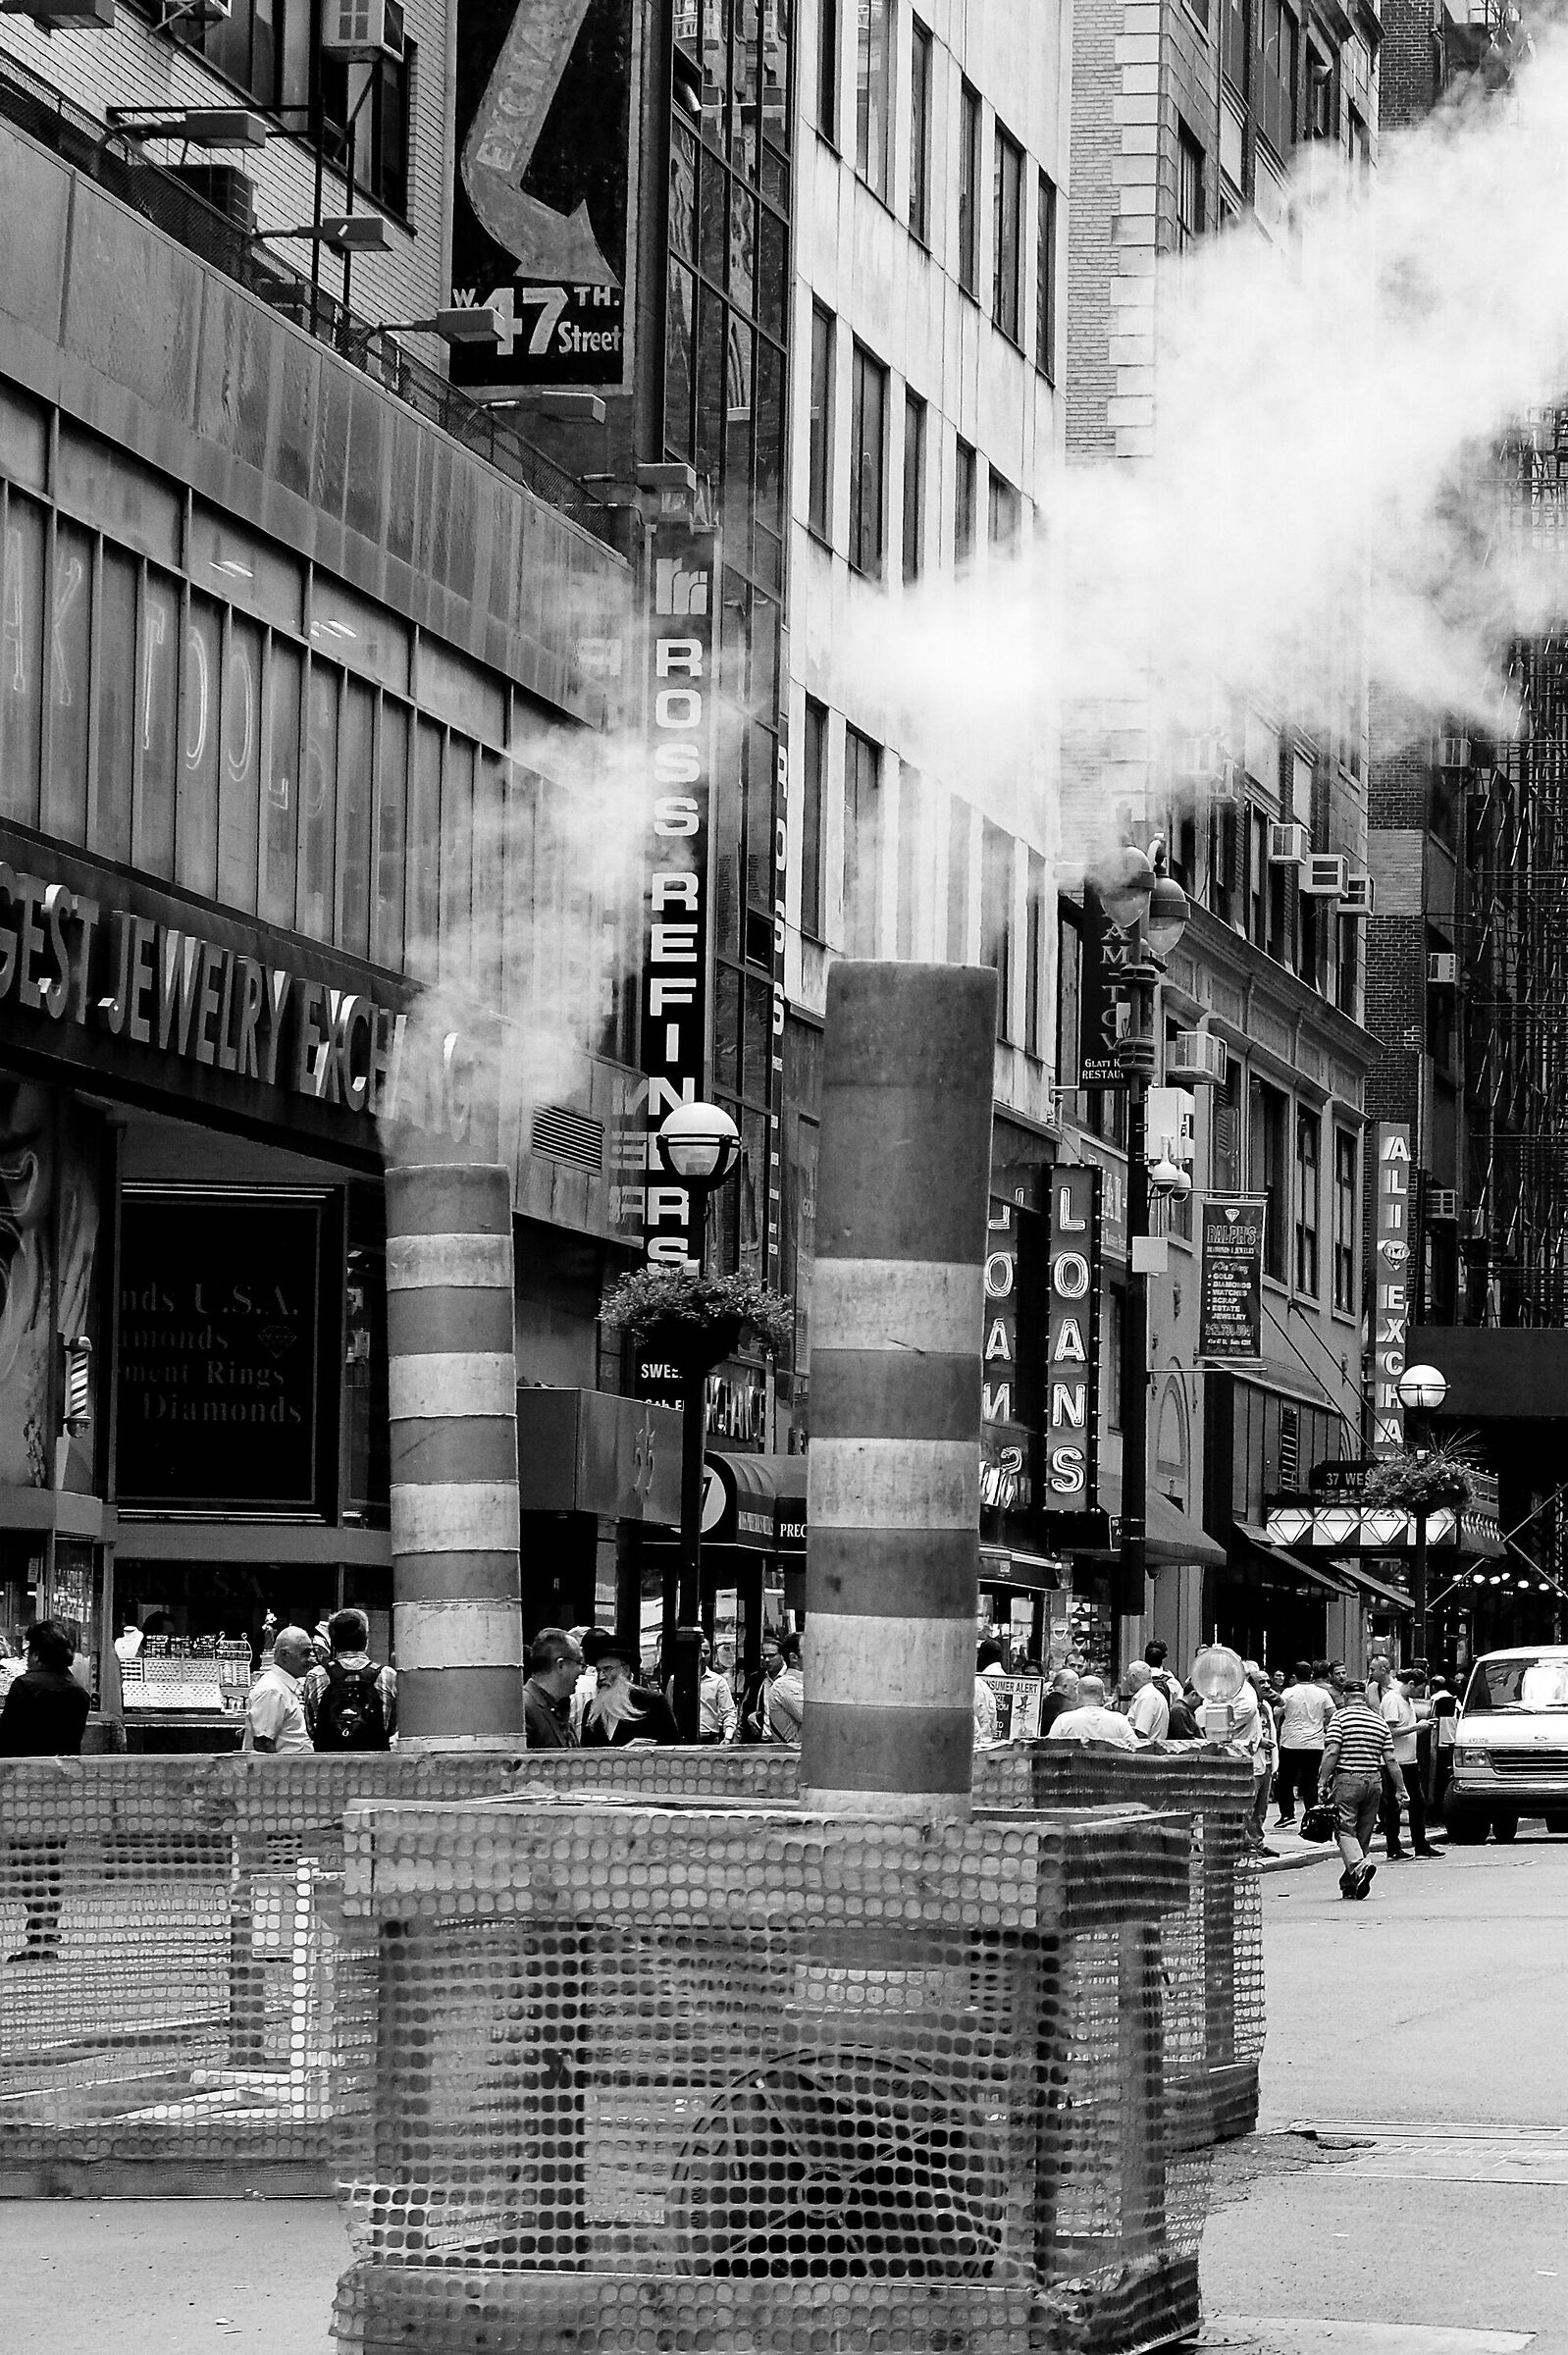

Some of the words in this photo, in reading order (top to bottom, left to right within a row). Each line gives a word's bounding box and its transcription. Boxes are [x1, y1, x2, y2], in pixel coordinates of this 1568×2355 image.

[483, 288, 569, 355] 47
[573, 286, 621, 307] TH.
[557, 321, 622, 354] Street
[653, 639, 704, 836] ROSS
[98, 909, 294, 1085] JEWELRY
[1385, 1135, 1412, 1230] ALI
[192, 1282, 299, 1316] U.S.A.
[1213, 1281, 1252, 1289] DIAMONDS
[1212, 1304, 1241, 1313] ESTATE
[1050, 1187, 1090, 1494] LOANS
[206, 1359, 285, 1389] Rings
[1383, 1284, 1405, 1444] EXCHA
[143, 1390, 302, 1423] Diamonds
[1326, 1472, 1339, 1486] 37
[1015, 1681, 1038, 1694] ALERT
